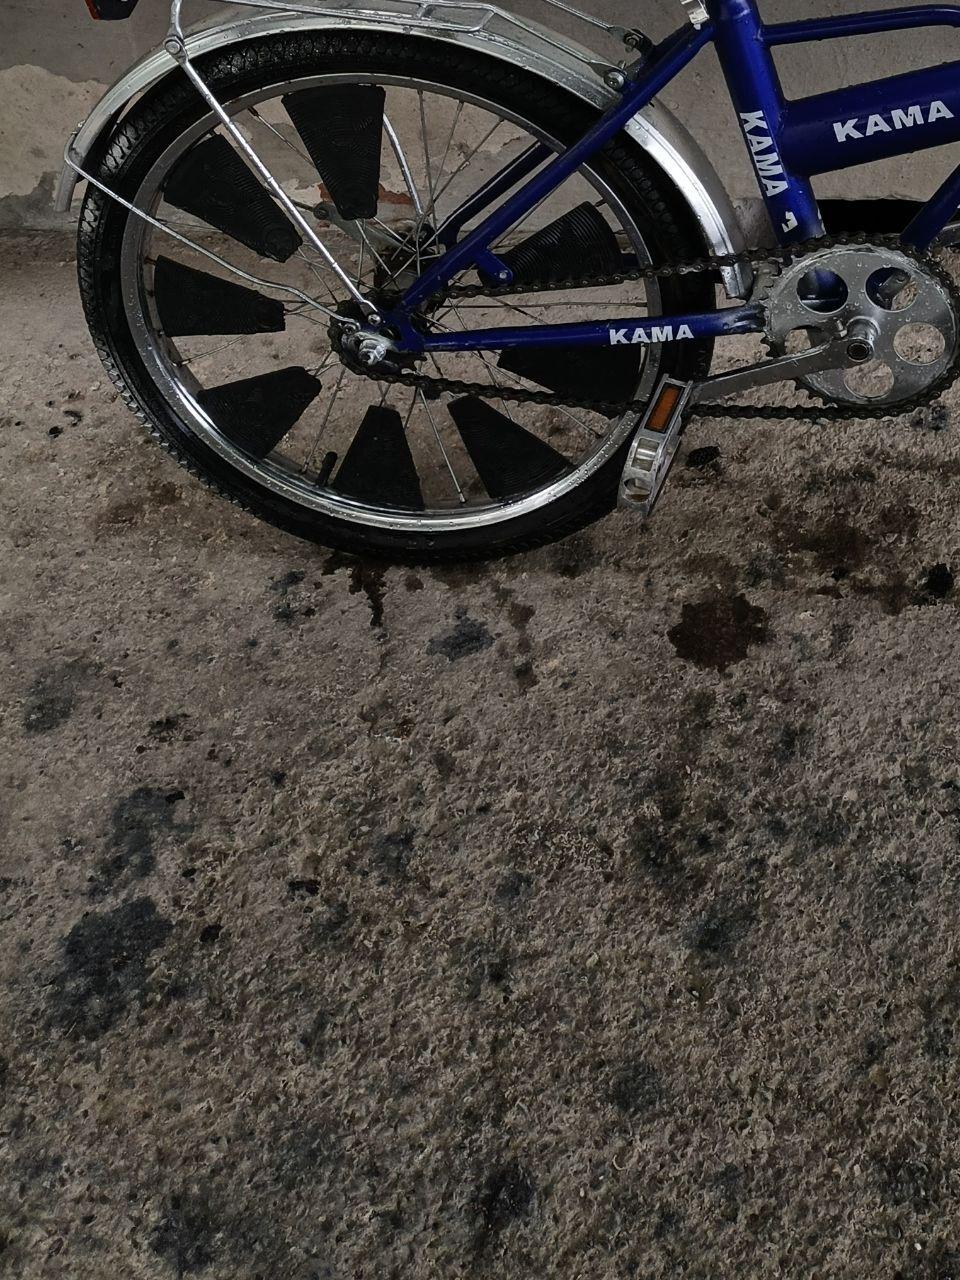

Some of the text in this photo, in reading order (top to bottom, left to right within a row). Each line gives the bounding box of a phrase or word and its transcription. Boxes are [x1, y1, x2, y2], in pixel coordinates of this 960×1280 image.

[833, 100, 954, 142] KAMA
[739, 109, 789, 197] KAMA
[609, 324, 695, 345] KAMA
